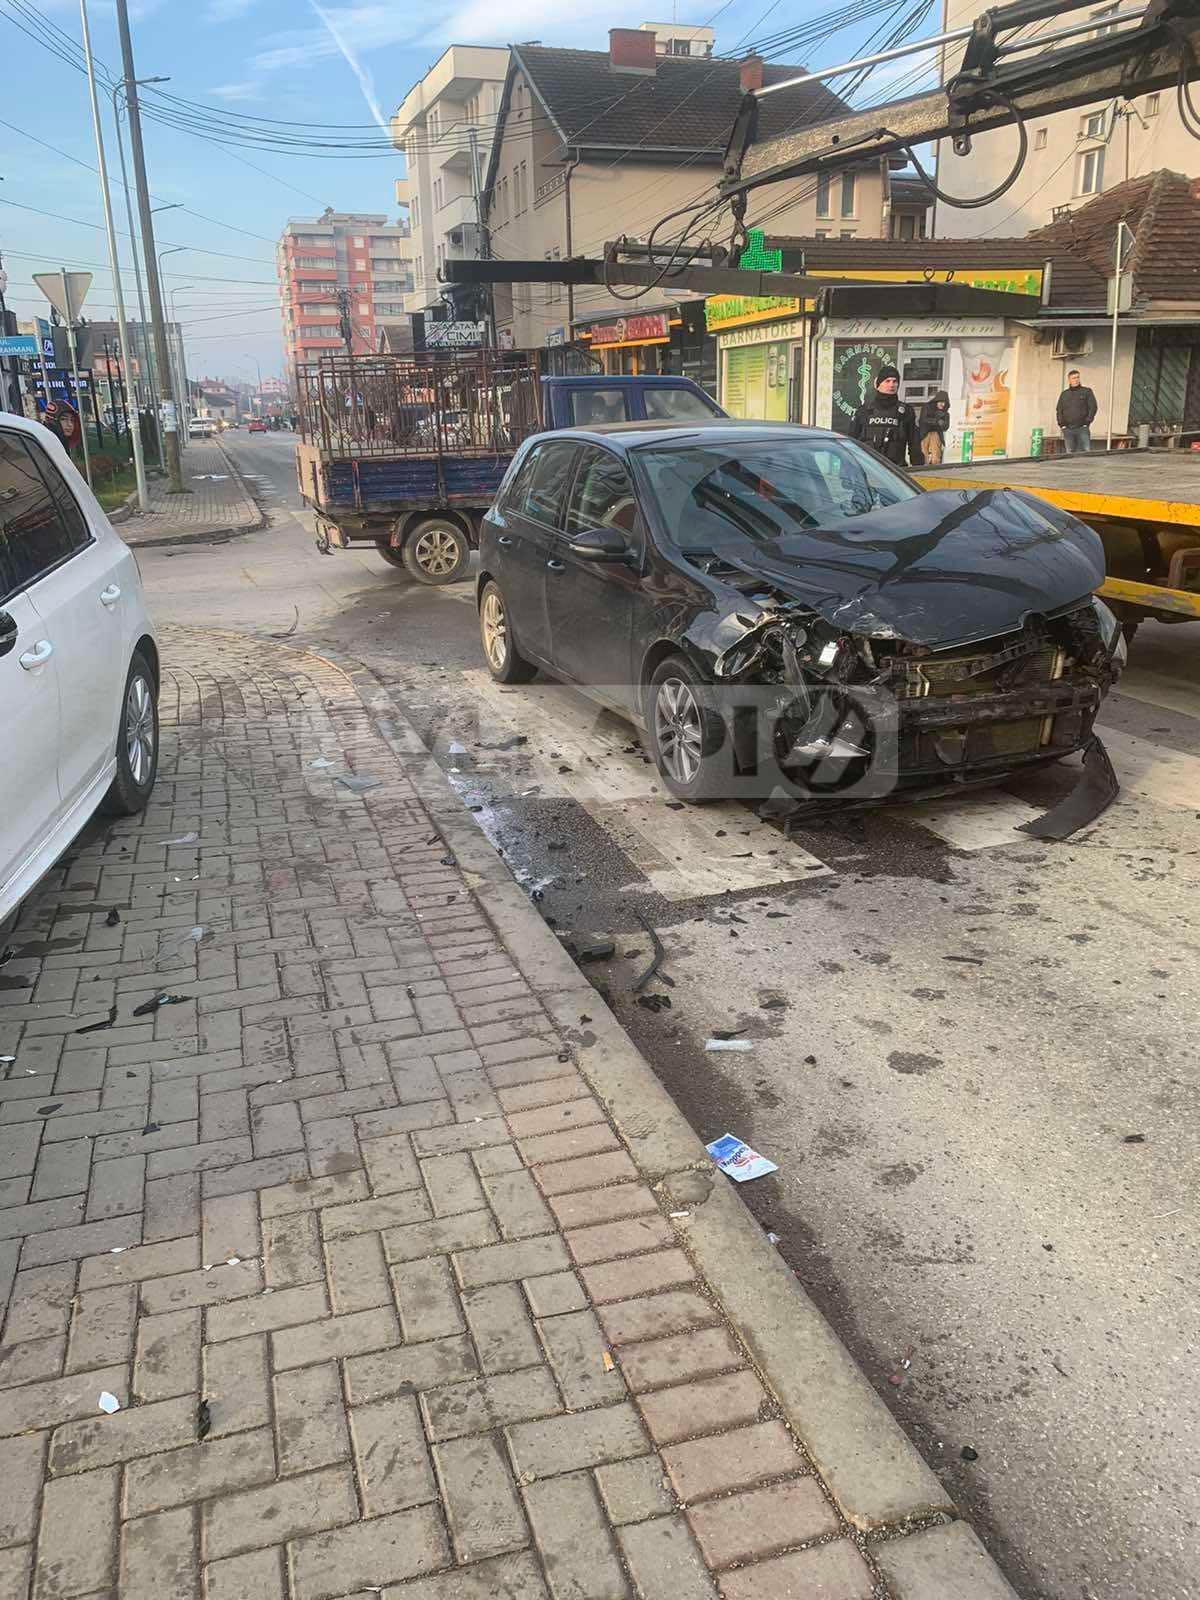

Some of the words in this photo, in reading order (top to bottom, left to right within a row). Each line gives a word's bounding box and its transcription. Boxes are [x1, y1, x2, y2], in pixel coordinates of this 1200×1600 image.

[926, 318, 994, 333] Pharm
[721, 321, 798, 346] BARNATORE
[868, 417, 899, 426] POLICE
